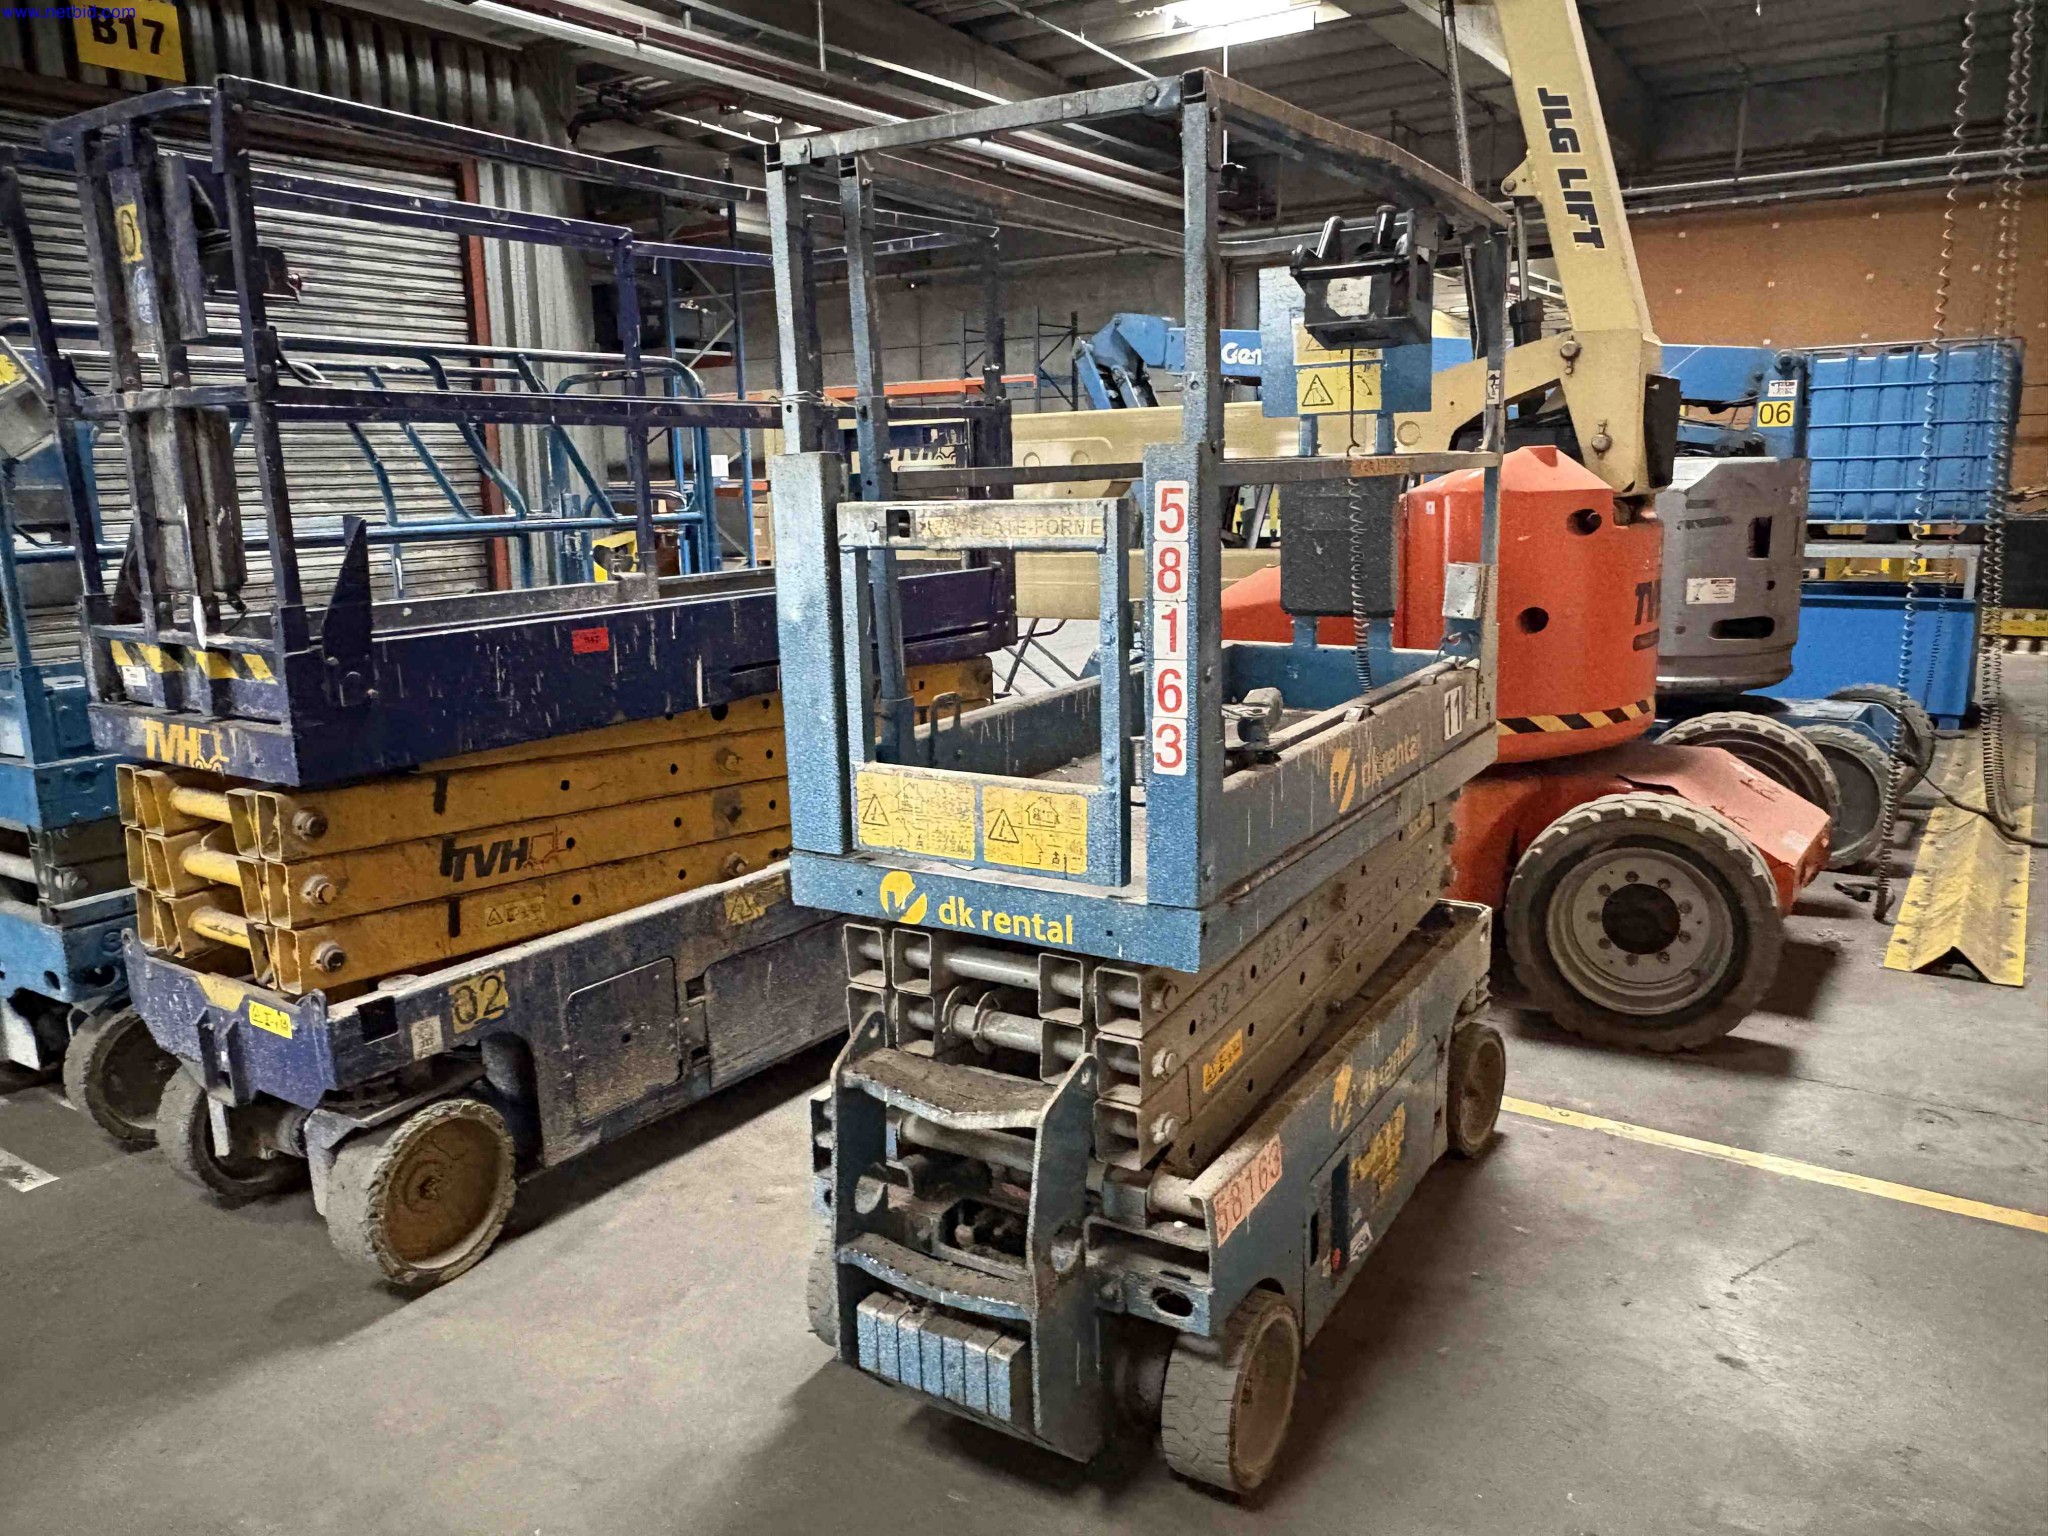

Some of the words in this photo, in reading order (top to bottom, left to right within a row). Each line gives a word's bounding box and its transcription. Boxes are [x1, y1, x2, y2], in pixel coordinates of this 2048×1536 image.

[89, 5, 164, 55] B17
[1537, 88, 1581, 153] JLG
[1557, 168, 1605, 249] LIFT
[1760, 402, 1791, 424] 06
[1155, 487, 1185, 769] 58163
[1445, 689, 1461, 736] 11
[142, 719, 199, 768] TVH
[938, 896, 975, 928] dk
[981, 909, 1073, 945] rental
[454, 974, 506, 1025] 02
[1216, 1142, 1281, 1240] 58163
